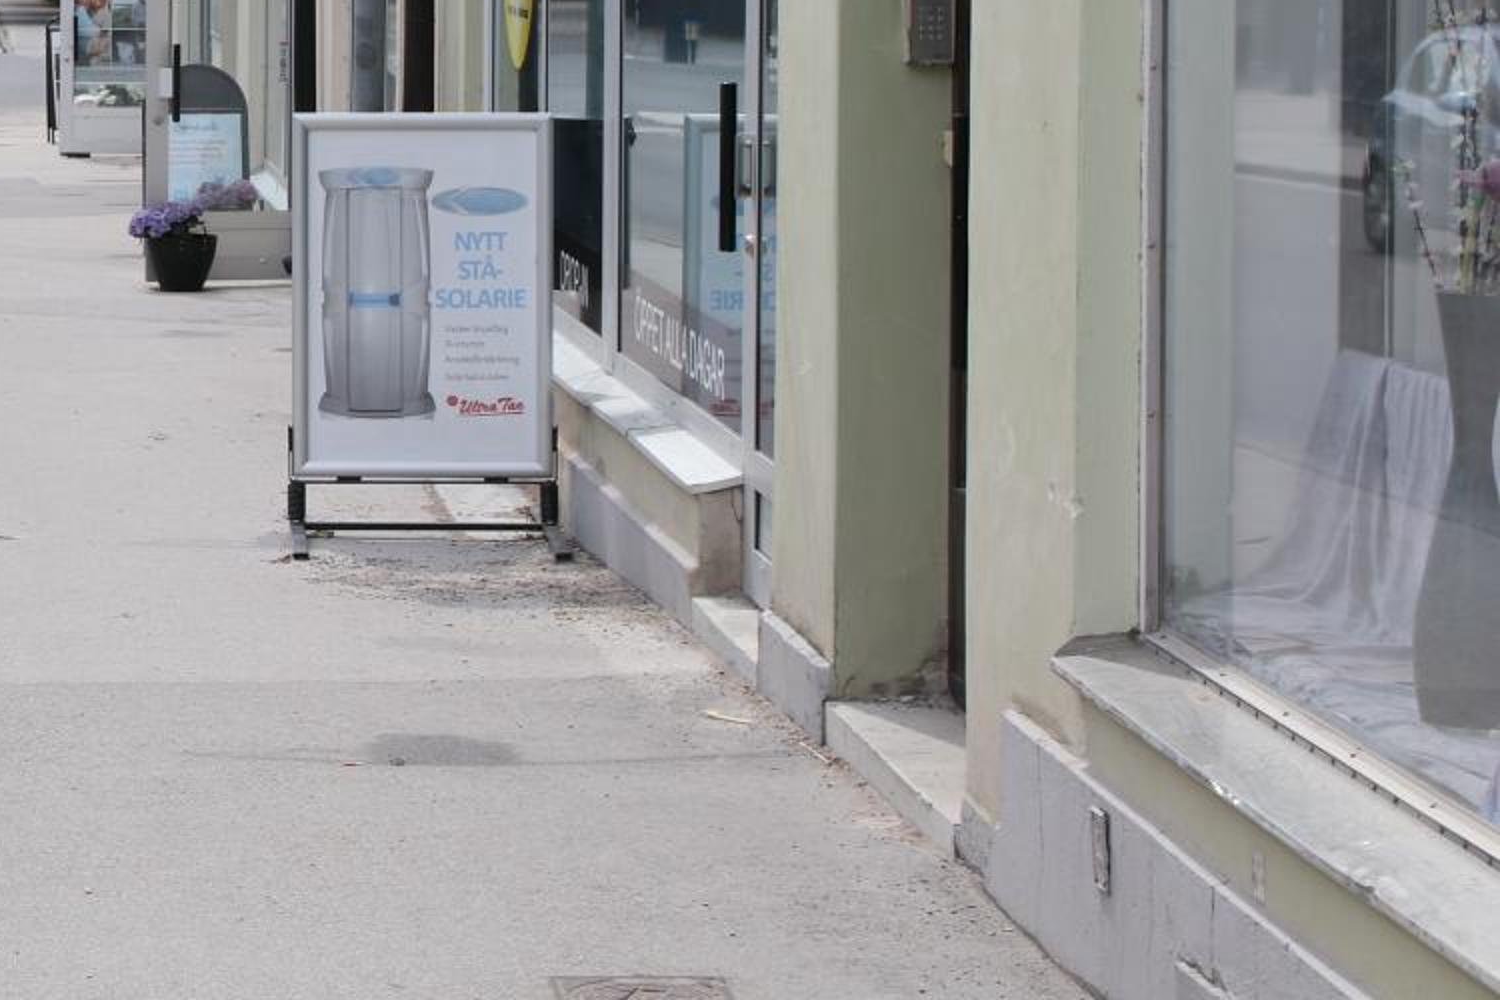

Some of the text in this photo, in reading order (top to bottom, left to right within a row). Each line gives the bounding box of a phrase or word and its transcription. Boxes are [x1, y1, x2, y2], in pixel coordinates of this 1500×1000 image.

[453, 231, 508, 251] NYTT
[435, 287, 527, 309] SOLARIE
[663, 314, 688, 375] ALLA
[689, 329, 725, 401] DAGAR
